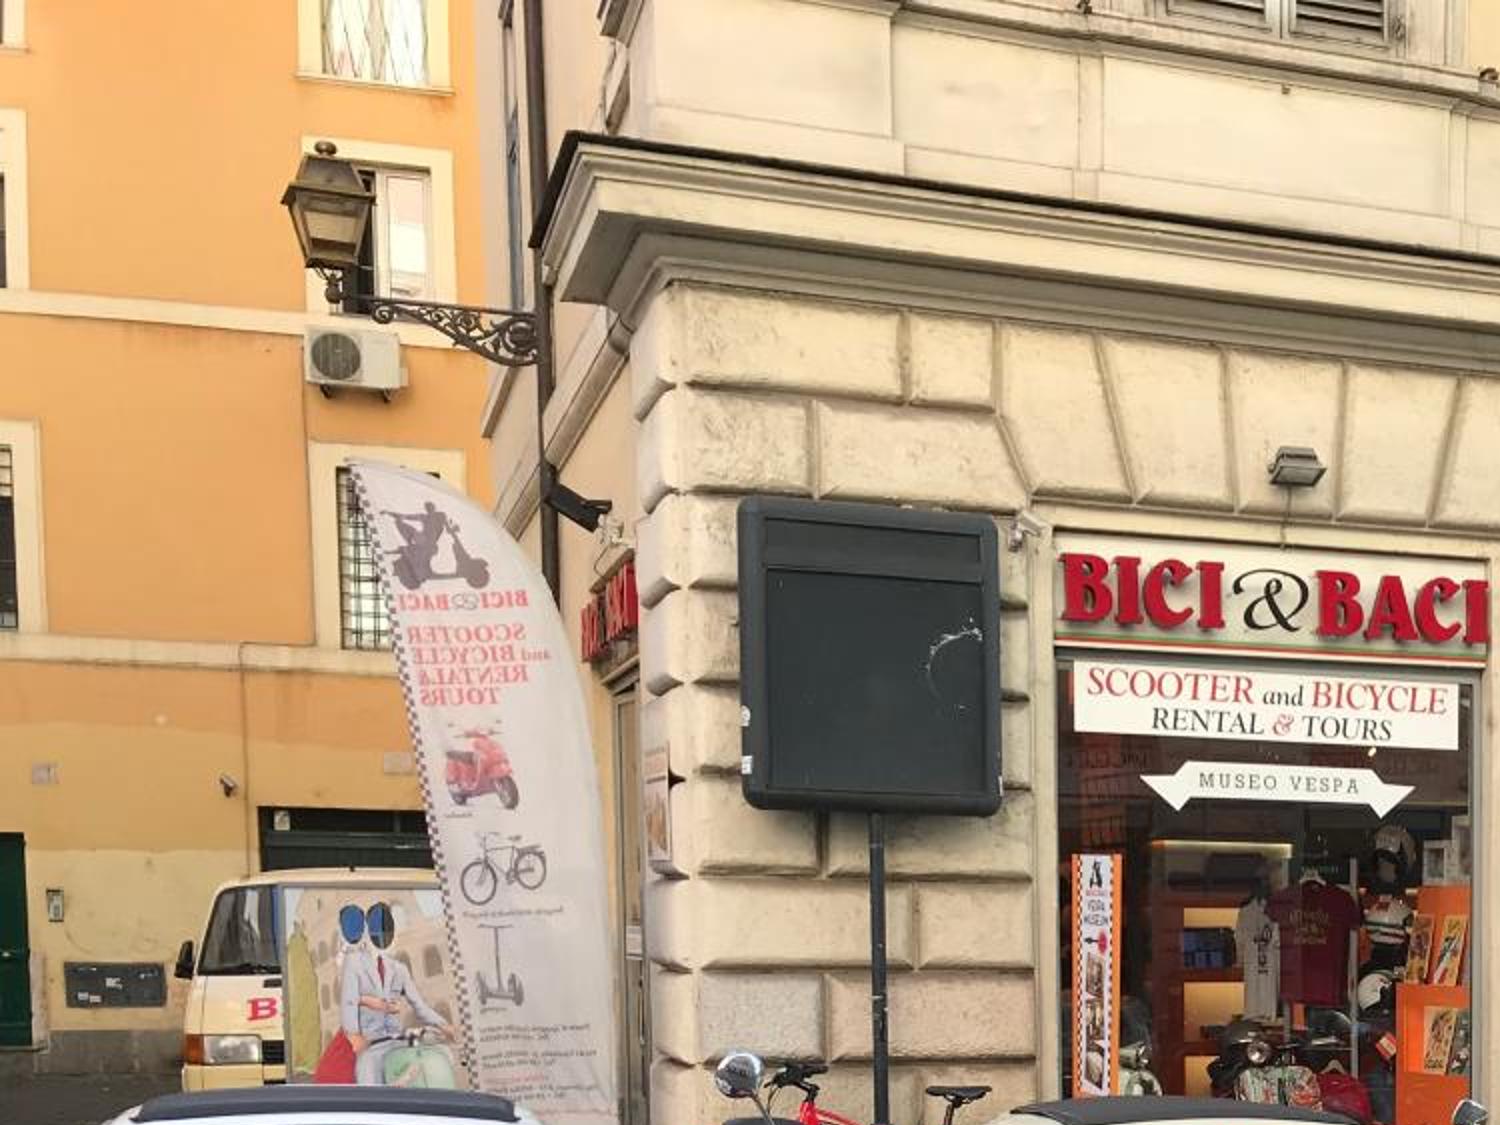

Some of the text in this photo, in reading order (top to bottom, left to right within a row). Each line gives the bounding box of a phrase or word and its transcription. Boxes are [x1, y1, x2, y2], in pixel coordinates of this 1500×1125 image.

[1058, 553, 1490, 645] BICI & BACI
[1086, 668, 1449, 716] SCOOTER and BICYCLE
[1151, 708, 1393, 742] RENTAL & TOURS
[1198, 771, 1360, 795] MUSEO VESPA
